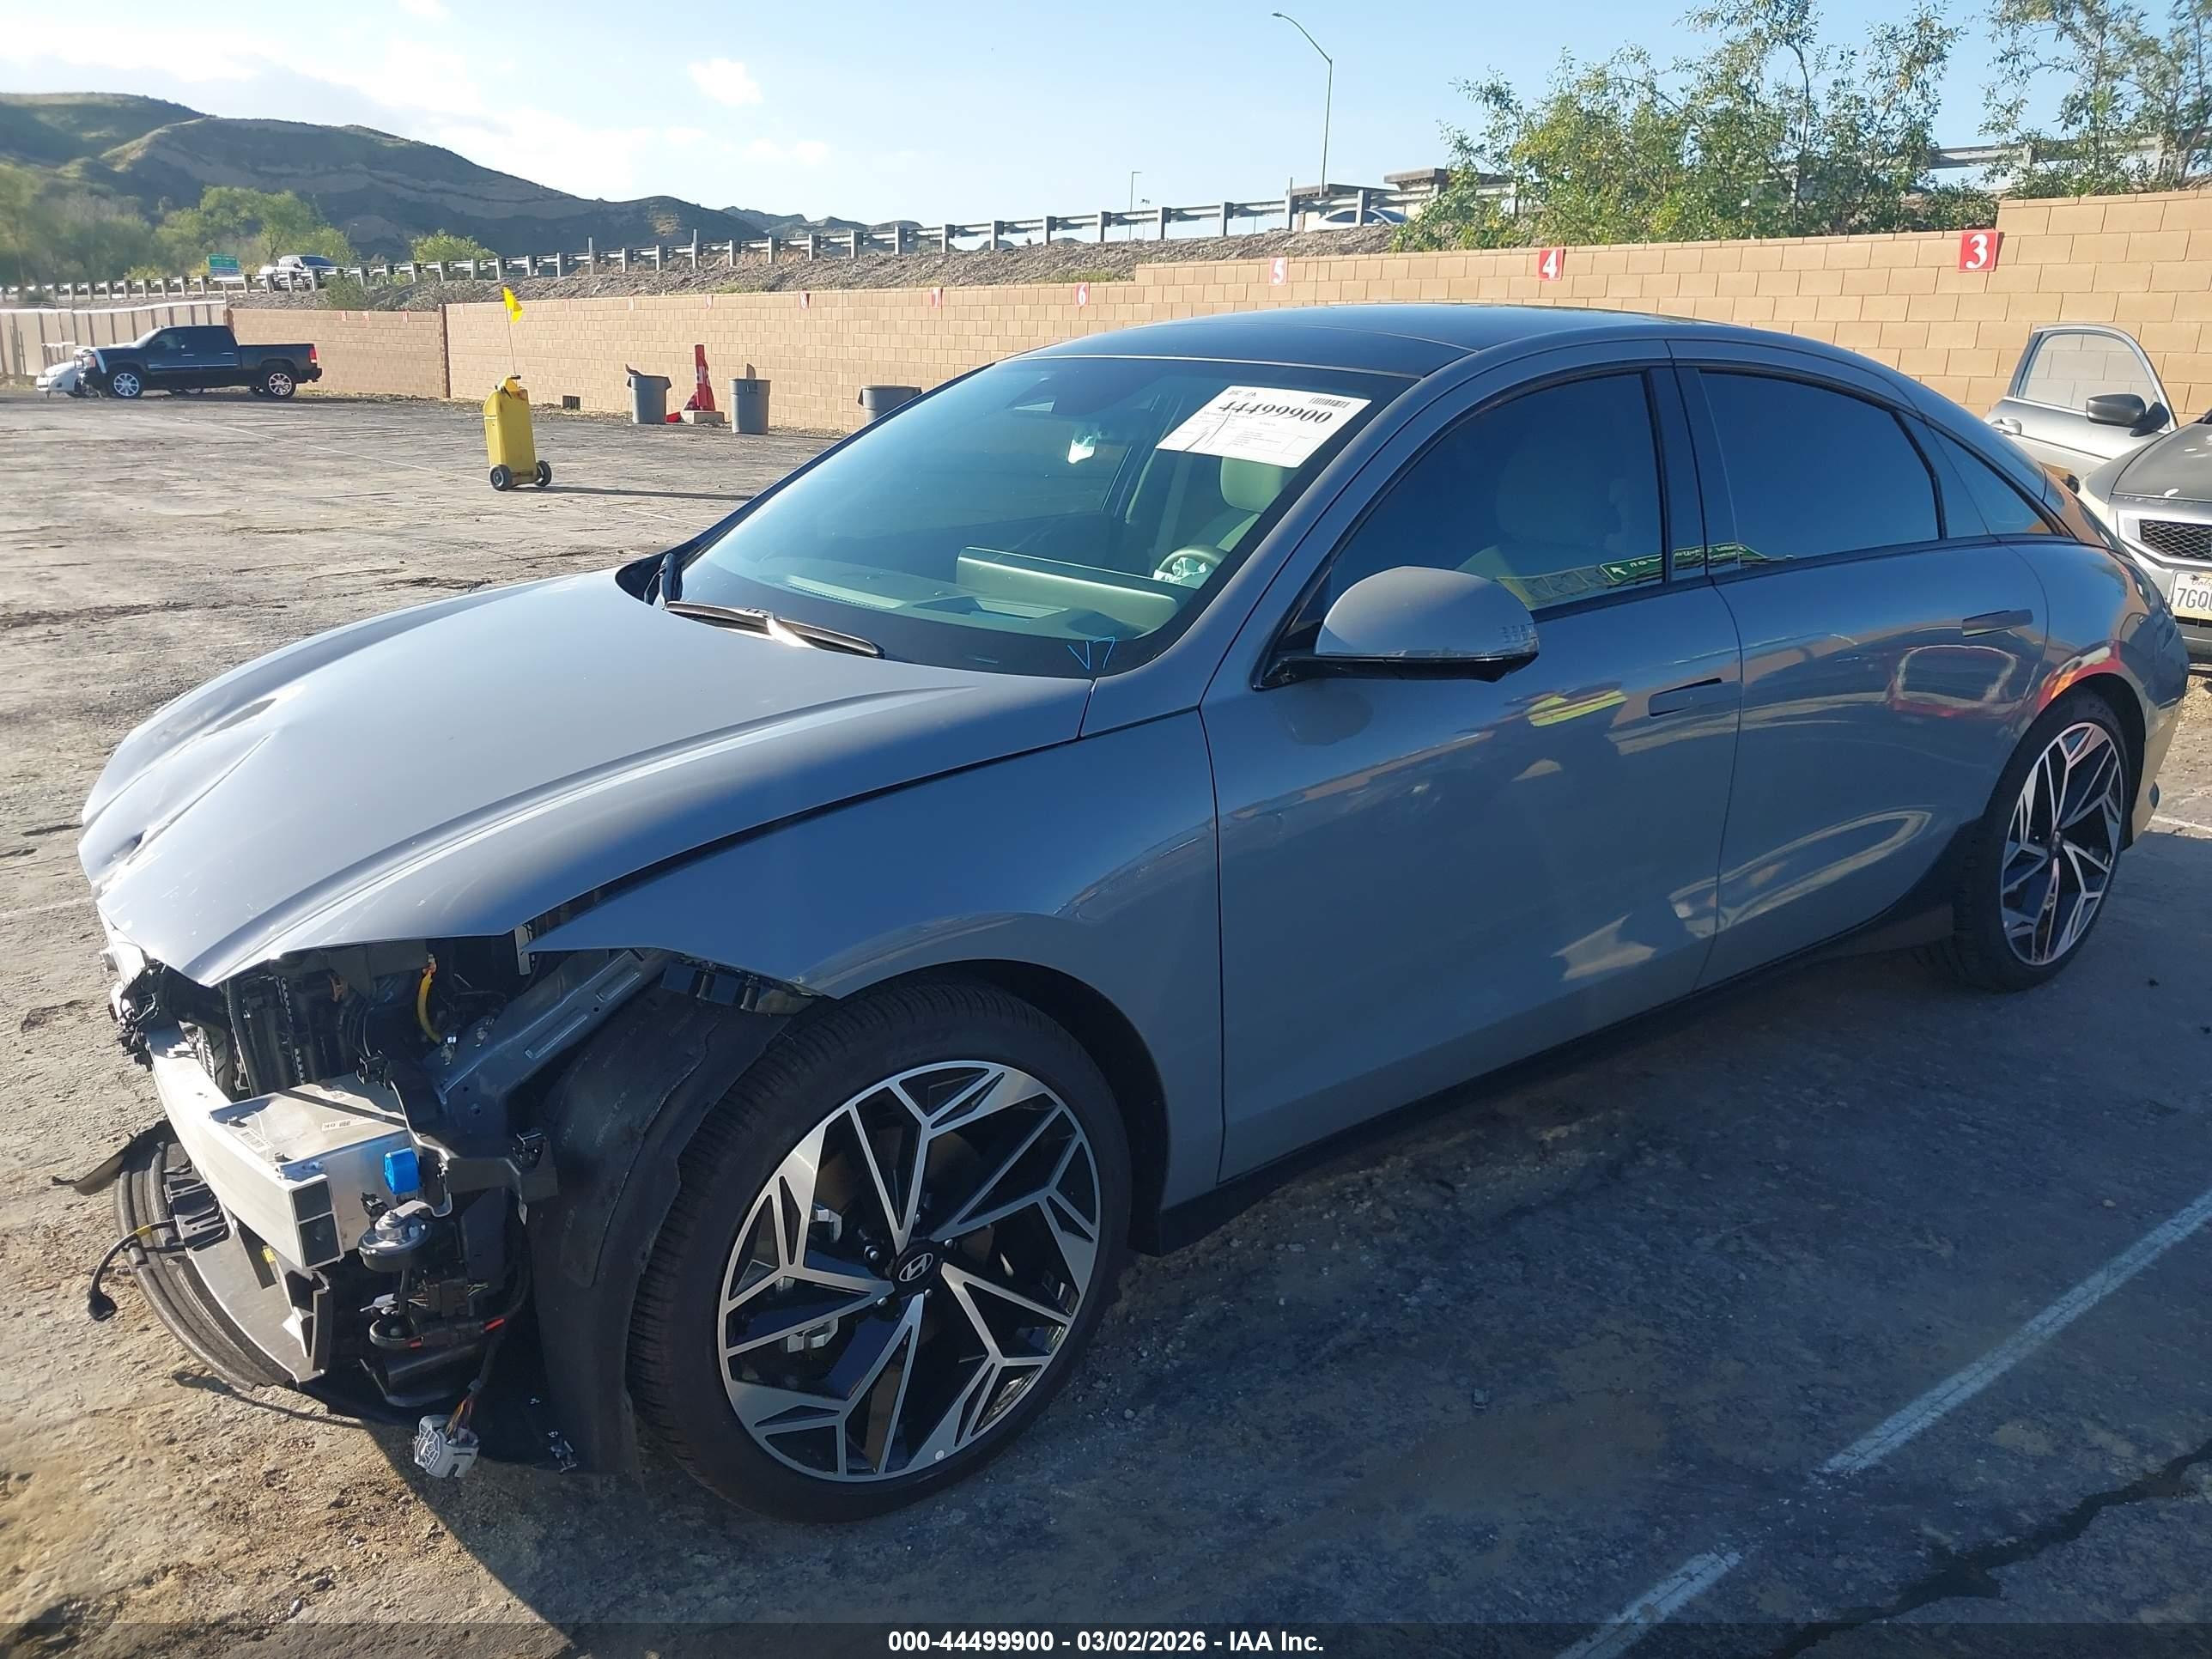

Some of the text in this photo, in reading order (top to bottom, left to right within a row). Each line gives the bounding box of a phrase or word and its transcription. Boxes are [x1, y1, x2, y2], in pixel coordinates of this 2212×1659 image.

[1965, 233, 1988, 269] 3
[1272, 258, 1285, 284] 5
[1542, 248, 1558, 281] 4
[1077, 283, 1086, 307] 6
[1216, 399, 1334, 424] 44499900
